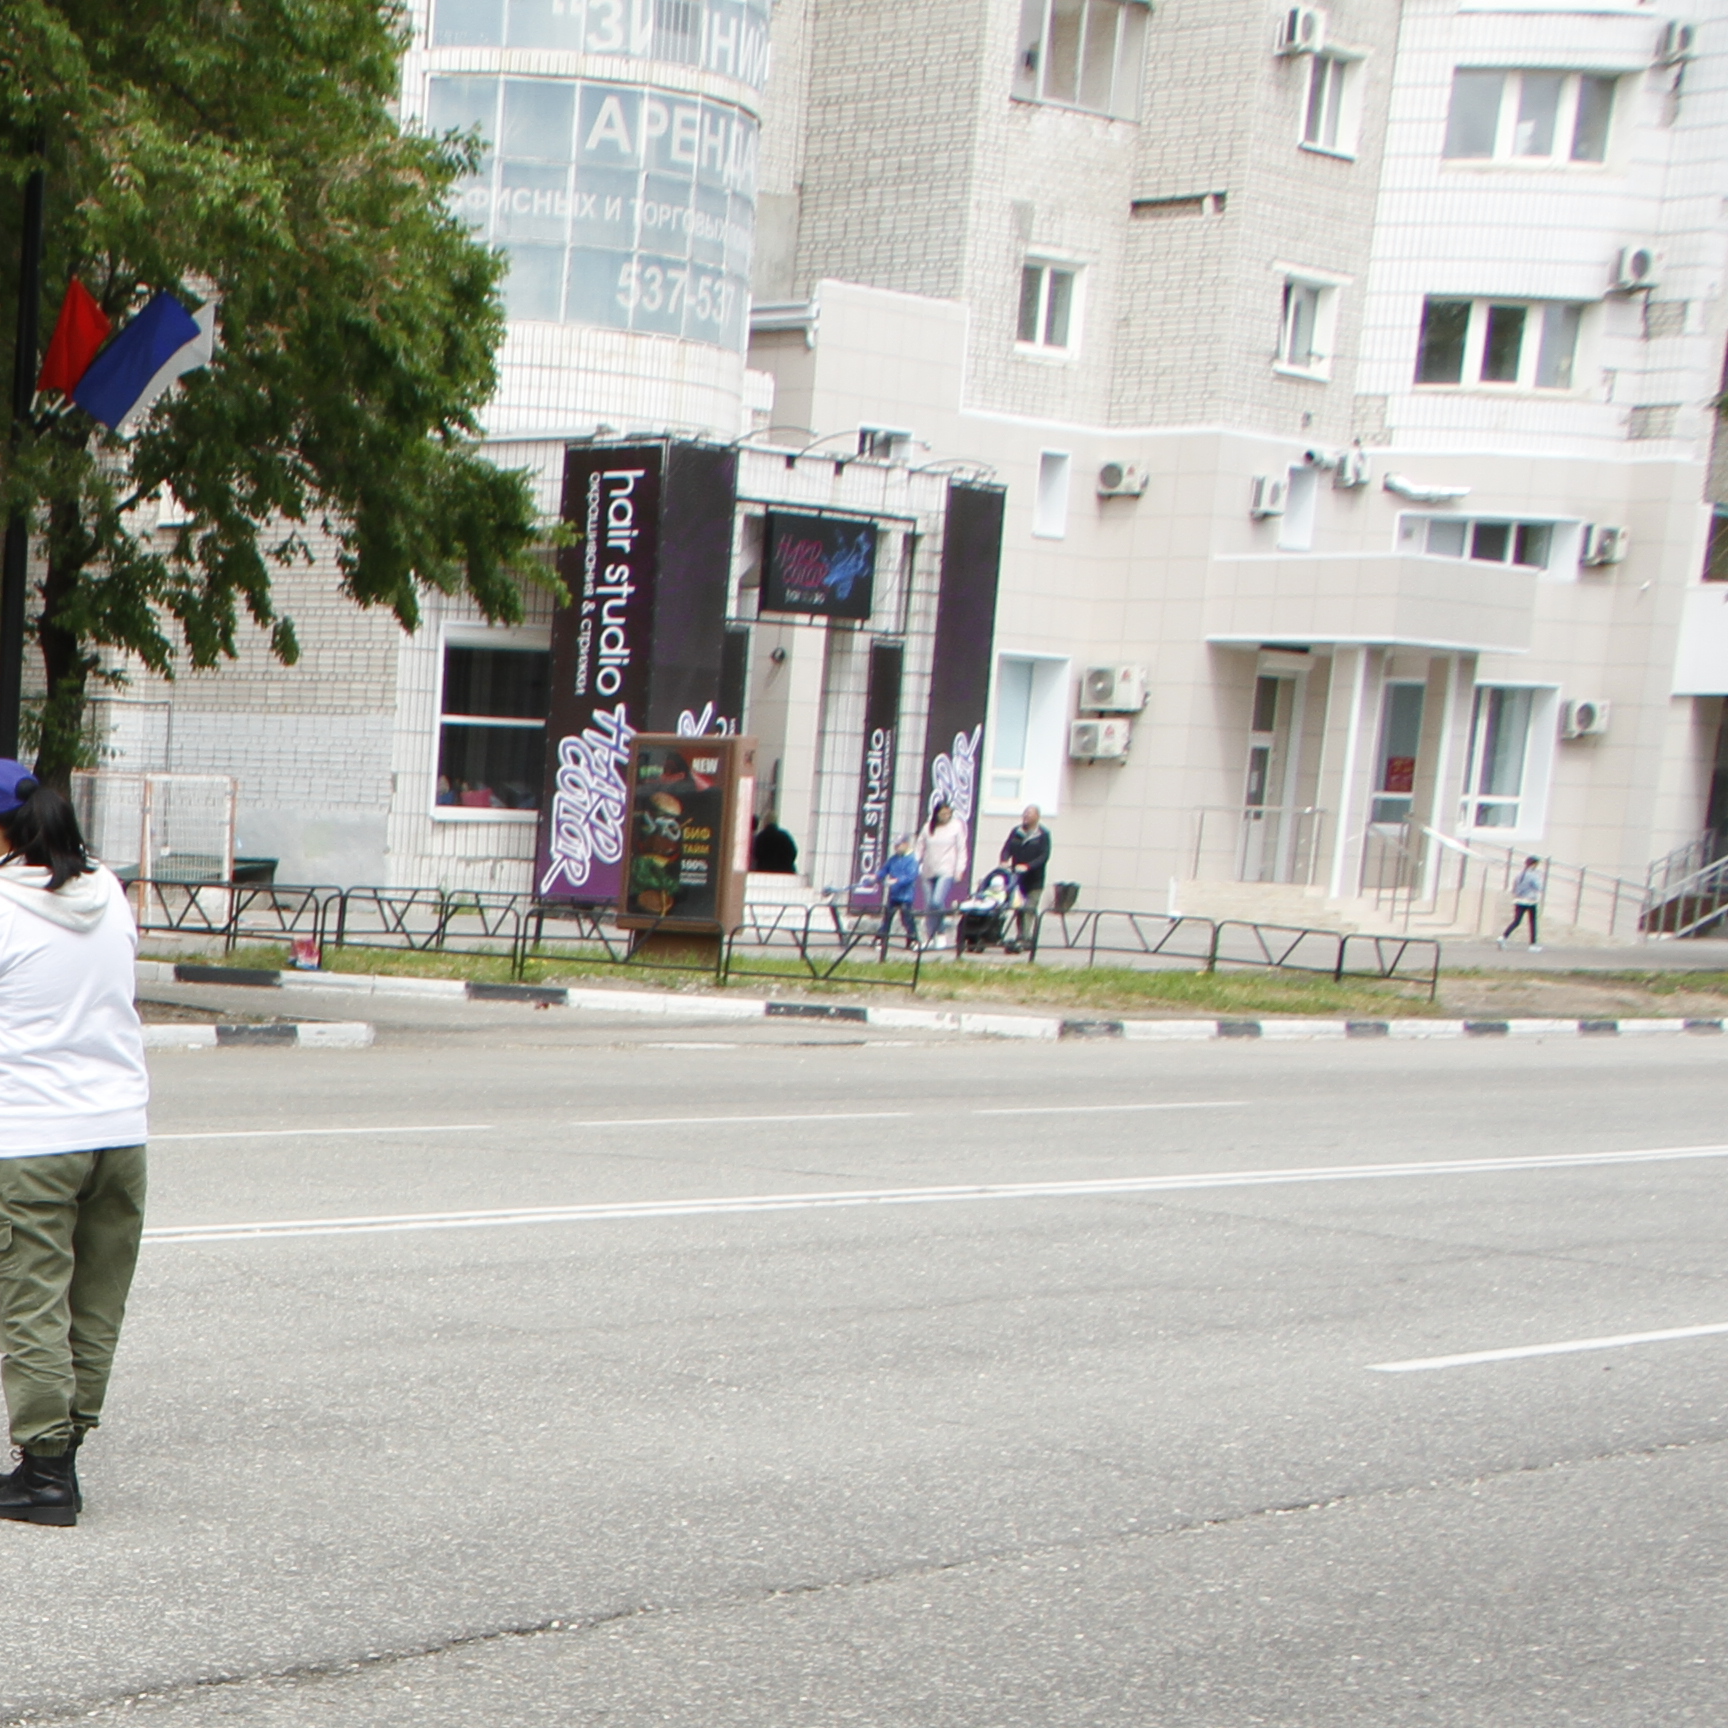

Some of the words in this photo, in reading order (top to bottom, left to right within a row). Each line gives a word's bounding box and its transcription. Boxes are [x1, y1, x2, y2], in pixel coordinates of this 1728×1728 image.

[584, 95, 760, 190] АРЕНДА
[605, 197, 622, 222] И
[602, 469, 645, 554] hair
[595, 564, 636, 697] studio
[691, 757, 719, 774] NEW
[863, 728, 886, 827] studio
[681, 858, 708, 872] 100%
